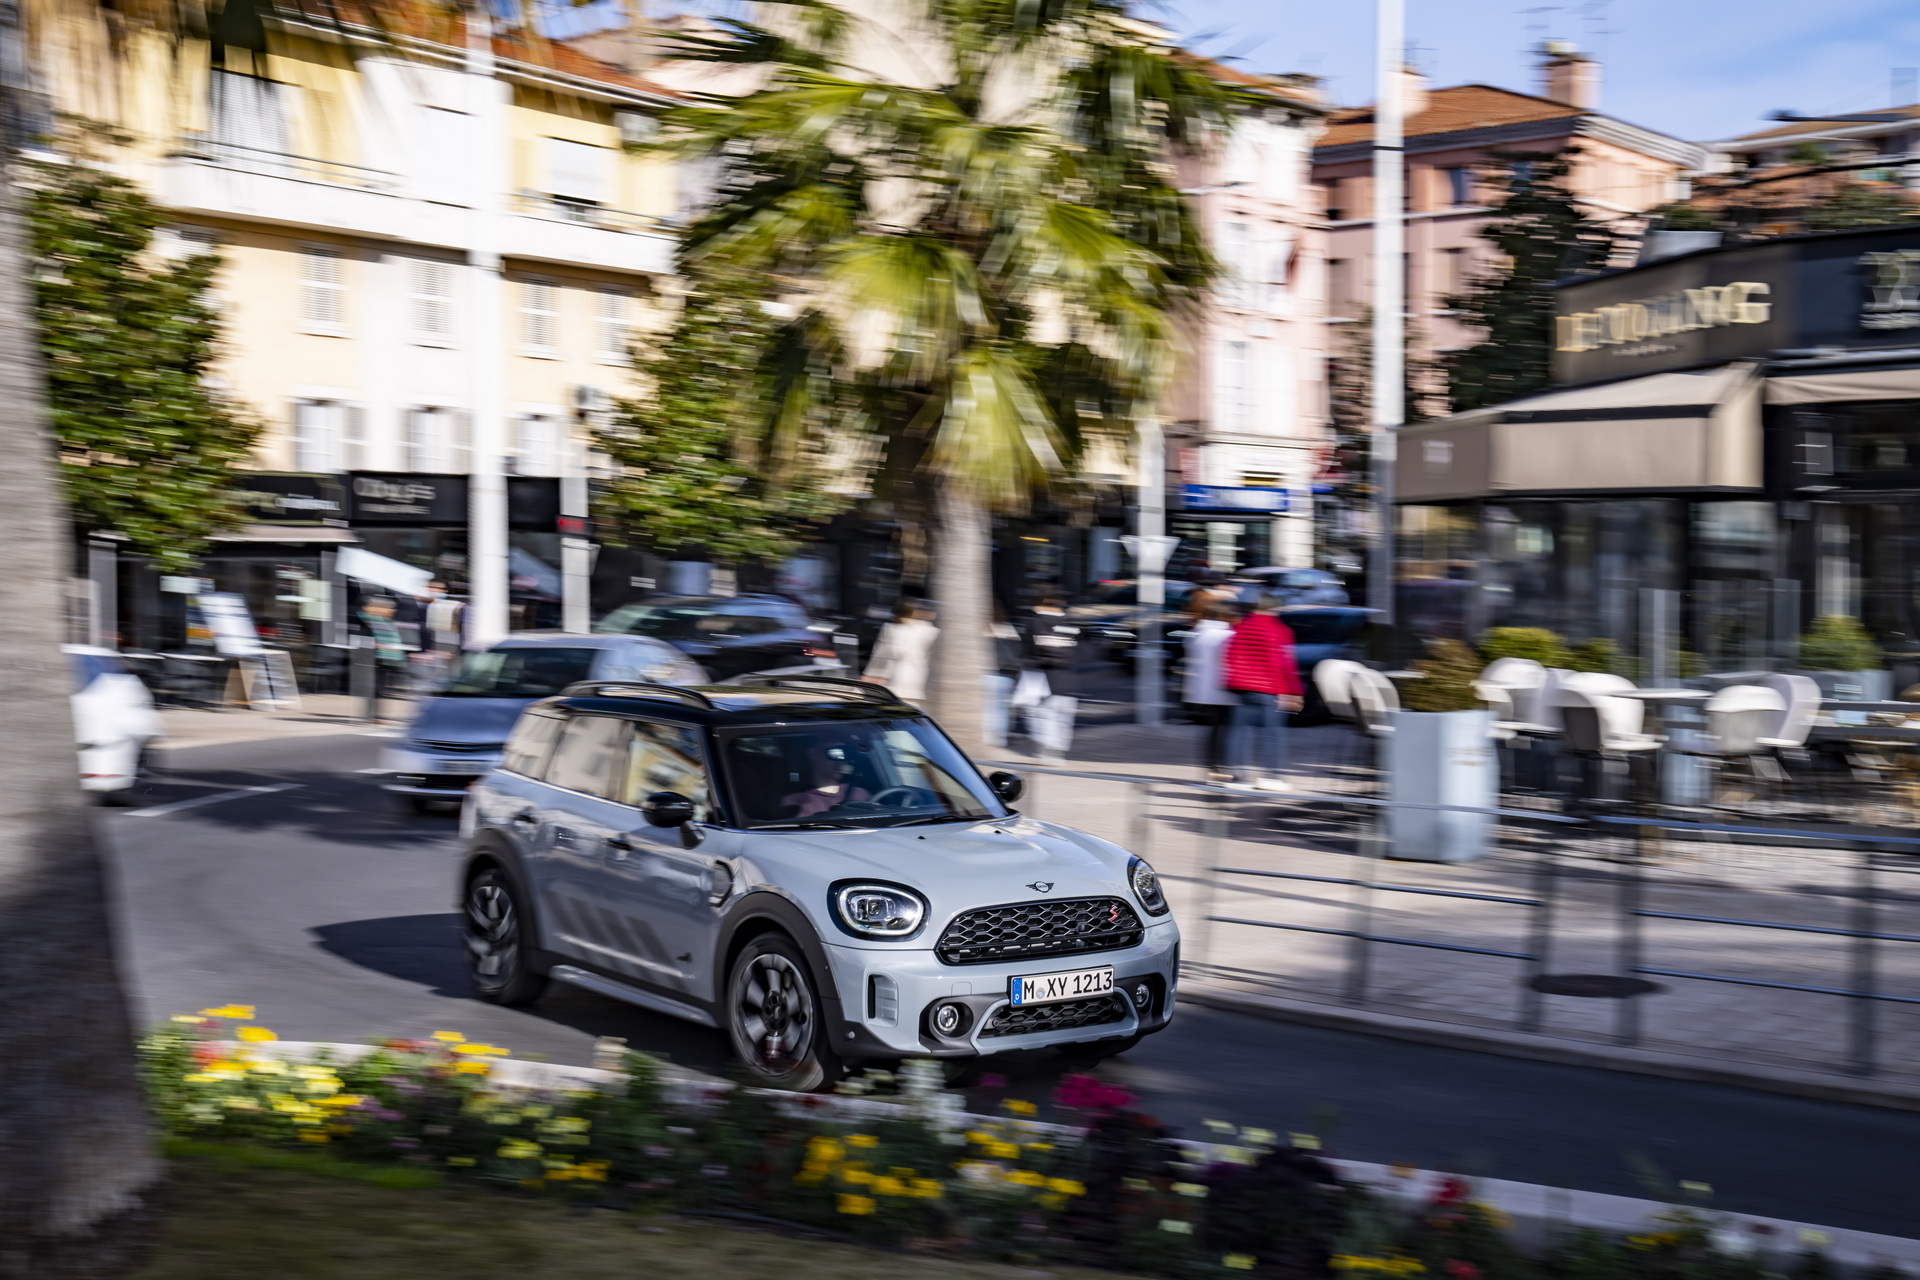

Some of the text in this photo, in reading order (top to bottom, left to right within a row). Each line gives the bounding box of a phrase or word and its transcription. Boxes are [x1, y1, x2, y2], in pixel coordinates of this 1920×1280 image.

[1108, 905, 1118, 922] S
[1023, 971, 1112, 1000] M XY 1213
